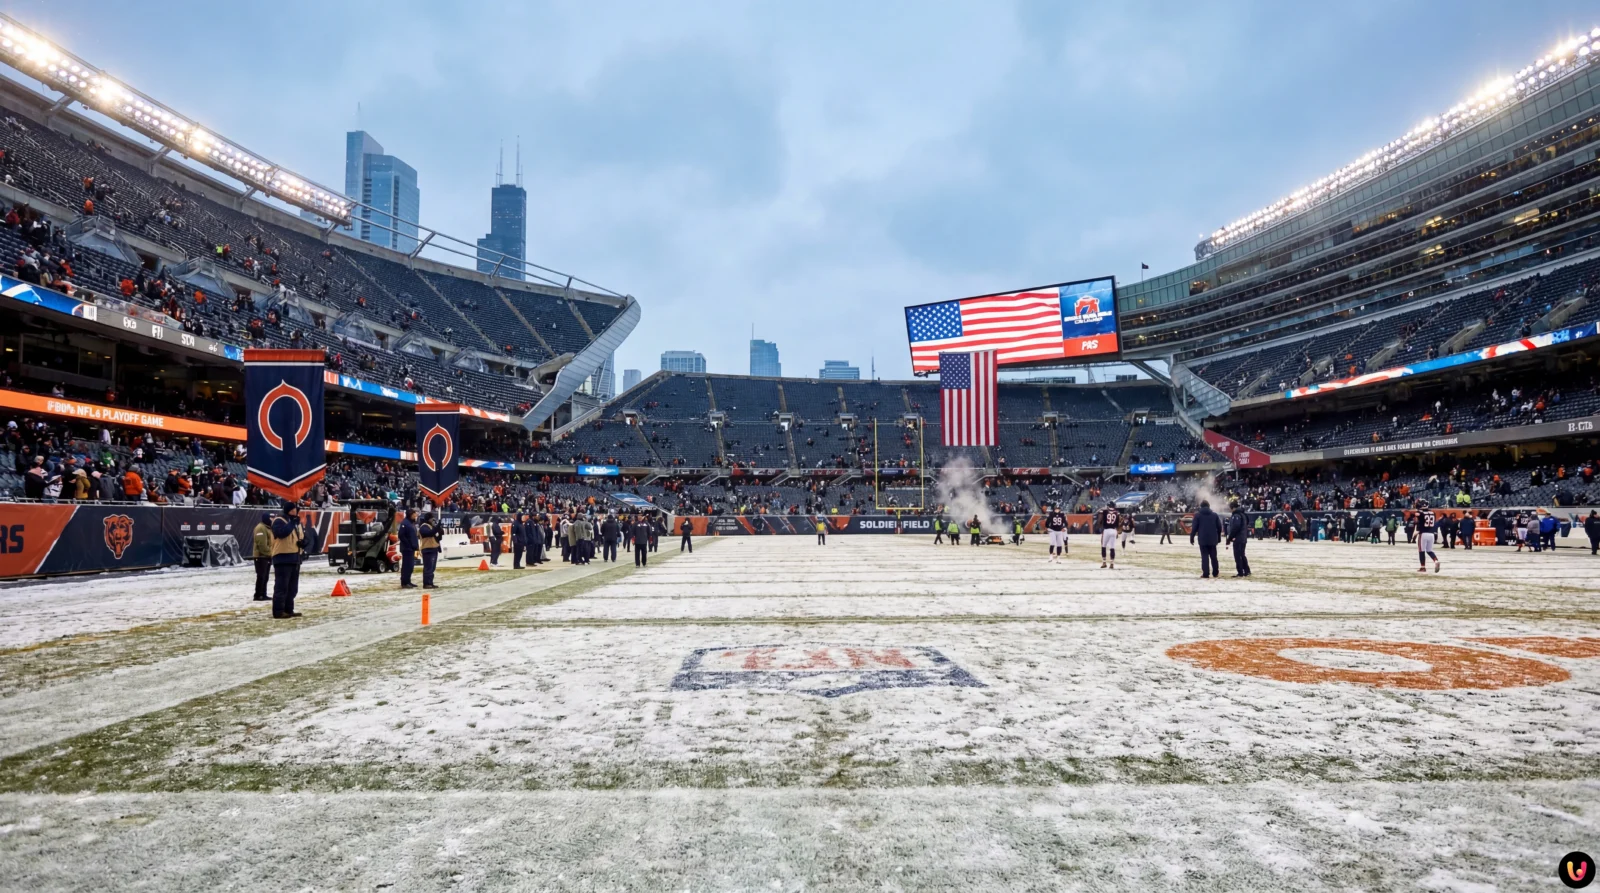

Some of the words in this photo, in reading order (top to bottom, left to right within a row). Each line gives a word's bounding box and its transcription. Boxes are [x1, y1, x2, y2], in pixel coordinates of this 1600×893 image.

[102, 409, 139, 423] PLAYOFF
[140, 415, 164, 427] GAME
[903, 520, 930, 529] FIELD
